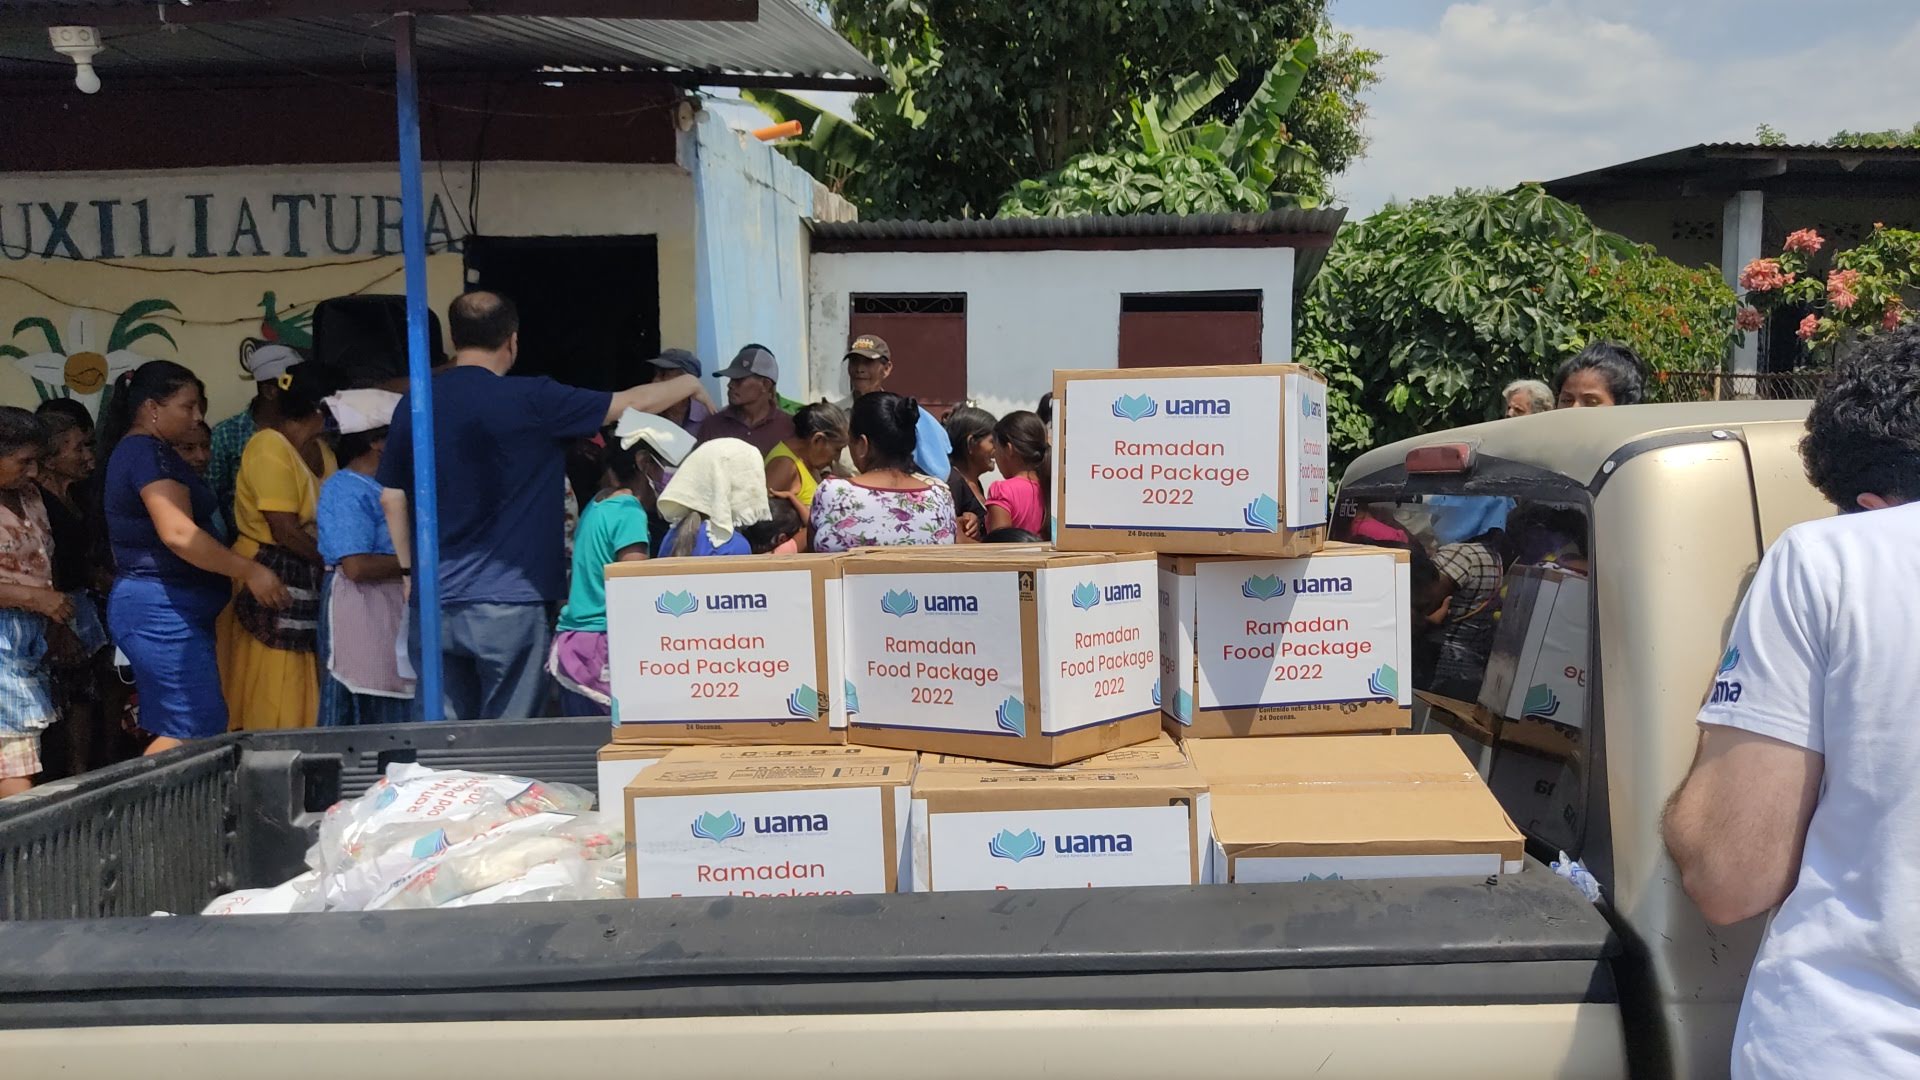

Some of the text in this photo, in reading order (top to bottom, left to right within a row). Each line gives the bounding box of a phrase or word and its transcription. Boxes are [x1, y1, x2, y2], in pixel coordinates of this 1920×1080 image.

[1165, 398, 1231, 415] uama
[1114, 439, 1224, 457] Ramadan
[1090, 463, 1250, 486] Food Package
[1142, 488, 1194, 506] 2022
[1104, 583, 1142, 601] uama
[1292, 576, 1353, 594] uama
[706, 593, 768, 610] uama
[924, 594, 979, 612] uama
[1246, 616, 1350, 636] Ramadan
[660, 634, 766, 652] Ramadan
[884, 636, 977, 656] Ramadan
[1074, 625, 1141, 650] Ramadan
[1223, 638, 1373, 661] Food Package
[638, 656, 790, 678] Food Package
[867, 660, 1000, 687] Food Package
[1060, 655, 1095, 679] Food
[1098, 648, 1155, 669] Package
[1273, 663, 1324, 682] 2022
[690, 681, 741, 699] 2022
[910, 686, 955, 706] 2022
[1093, 676, 1126, 699] 2022
[1259, 714, 1267, 722] 24
[754, 813, 829, 834] uama
[1054, 833, 1133, 853] uama
[697, 860, 826, 883] Ramadan
